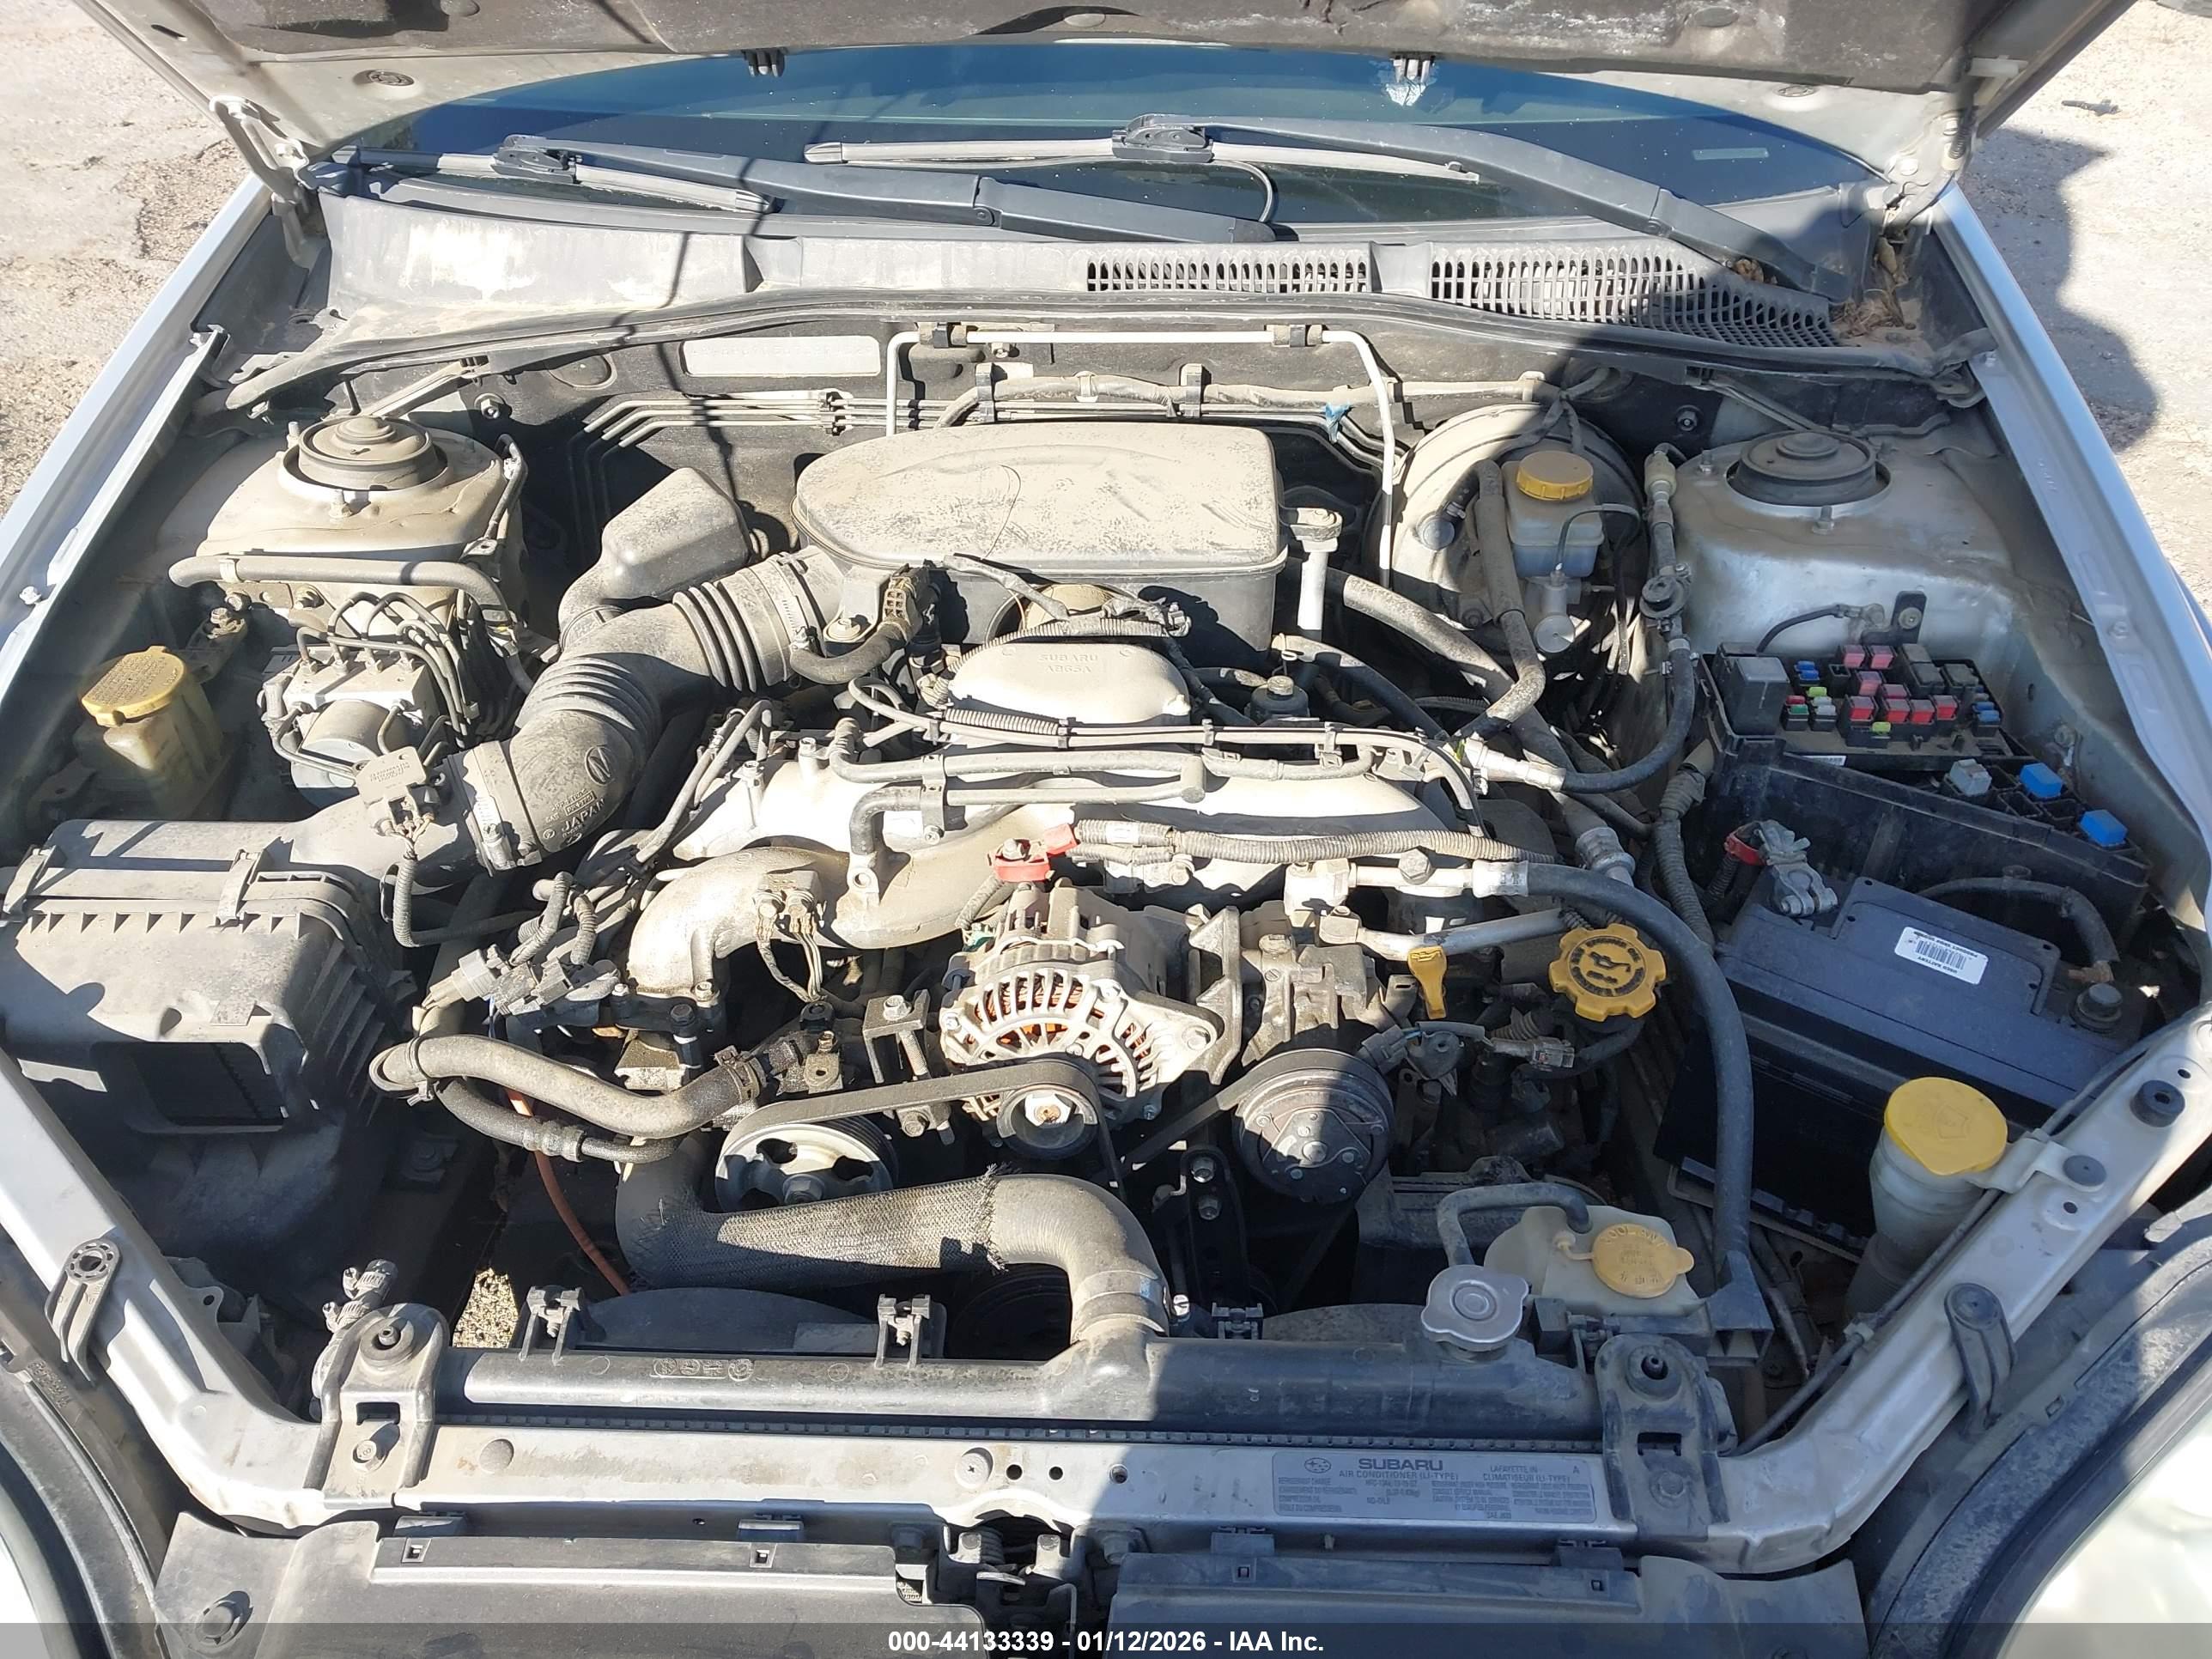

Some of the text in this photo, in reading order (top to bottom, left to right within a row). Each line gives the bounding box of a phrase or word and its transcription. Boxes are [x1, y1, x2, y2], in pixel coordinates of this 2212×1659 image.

[1037, 653, 1098, 663] SUBARU
[562, 797, 605, 831] JAPAN
[1358, 1458, 1443, 1471] SUBARU
[1357, 1470, 1418, 1480] CONDITIONER
